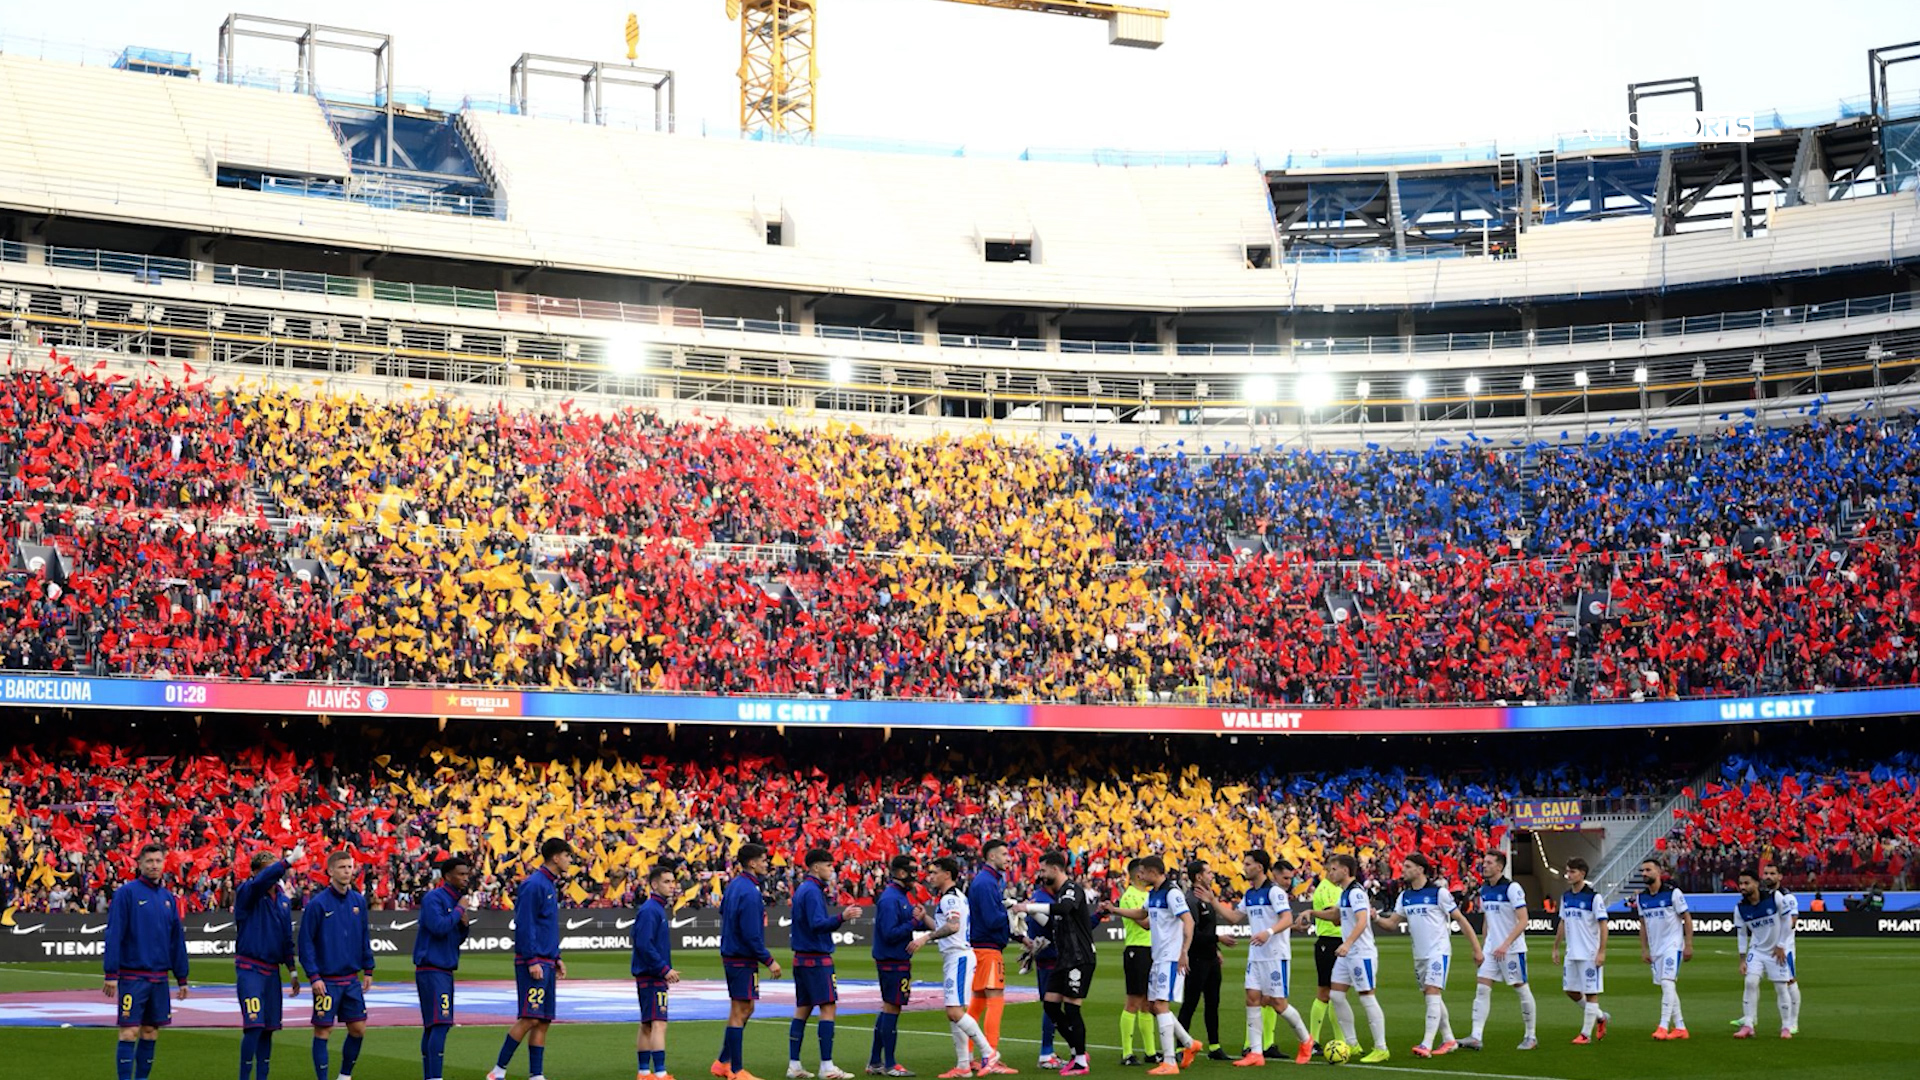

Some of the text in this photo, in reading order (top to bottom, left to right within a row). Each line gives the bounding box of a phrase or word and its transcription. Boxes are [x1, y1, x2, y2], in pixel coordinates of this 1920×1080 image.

[5, 679, 92, 701] BARCELONA
[165, 684, 206, 703] 01:28
[307, 687, 361, 709] ALAVÉS
[460, 697, 509, 708] ESTRELLA
[1720, 699, 1815, 719] UN CRIT
[738, 703, 831, 721] UN CRIT
[1221, 712, 1303, 728] VALENT
[1515, 801, 1581, 818] LA CAVA
[122, 994, 133, 1011] 9
[315, 995, 333, 1011] 20
[441, 994, 450, 1009] 3
[528, 988, 545, 1004] 22
[245, 997, 261, 1013] 10
